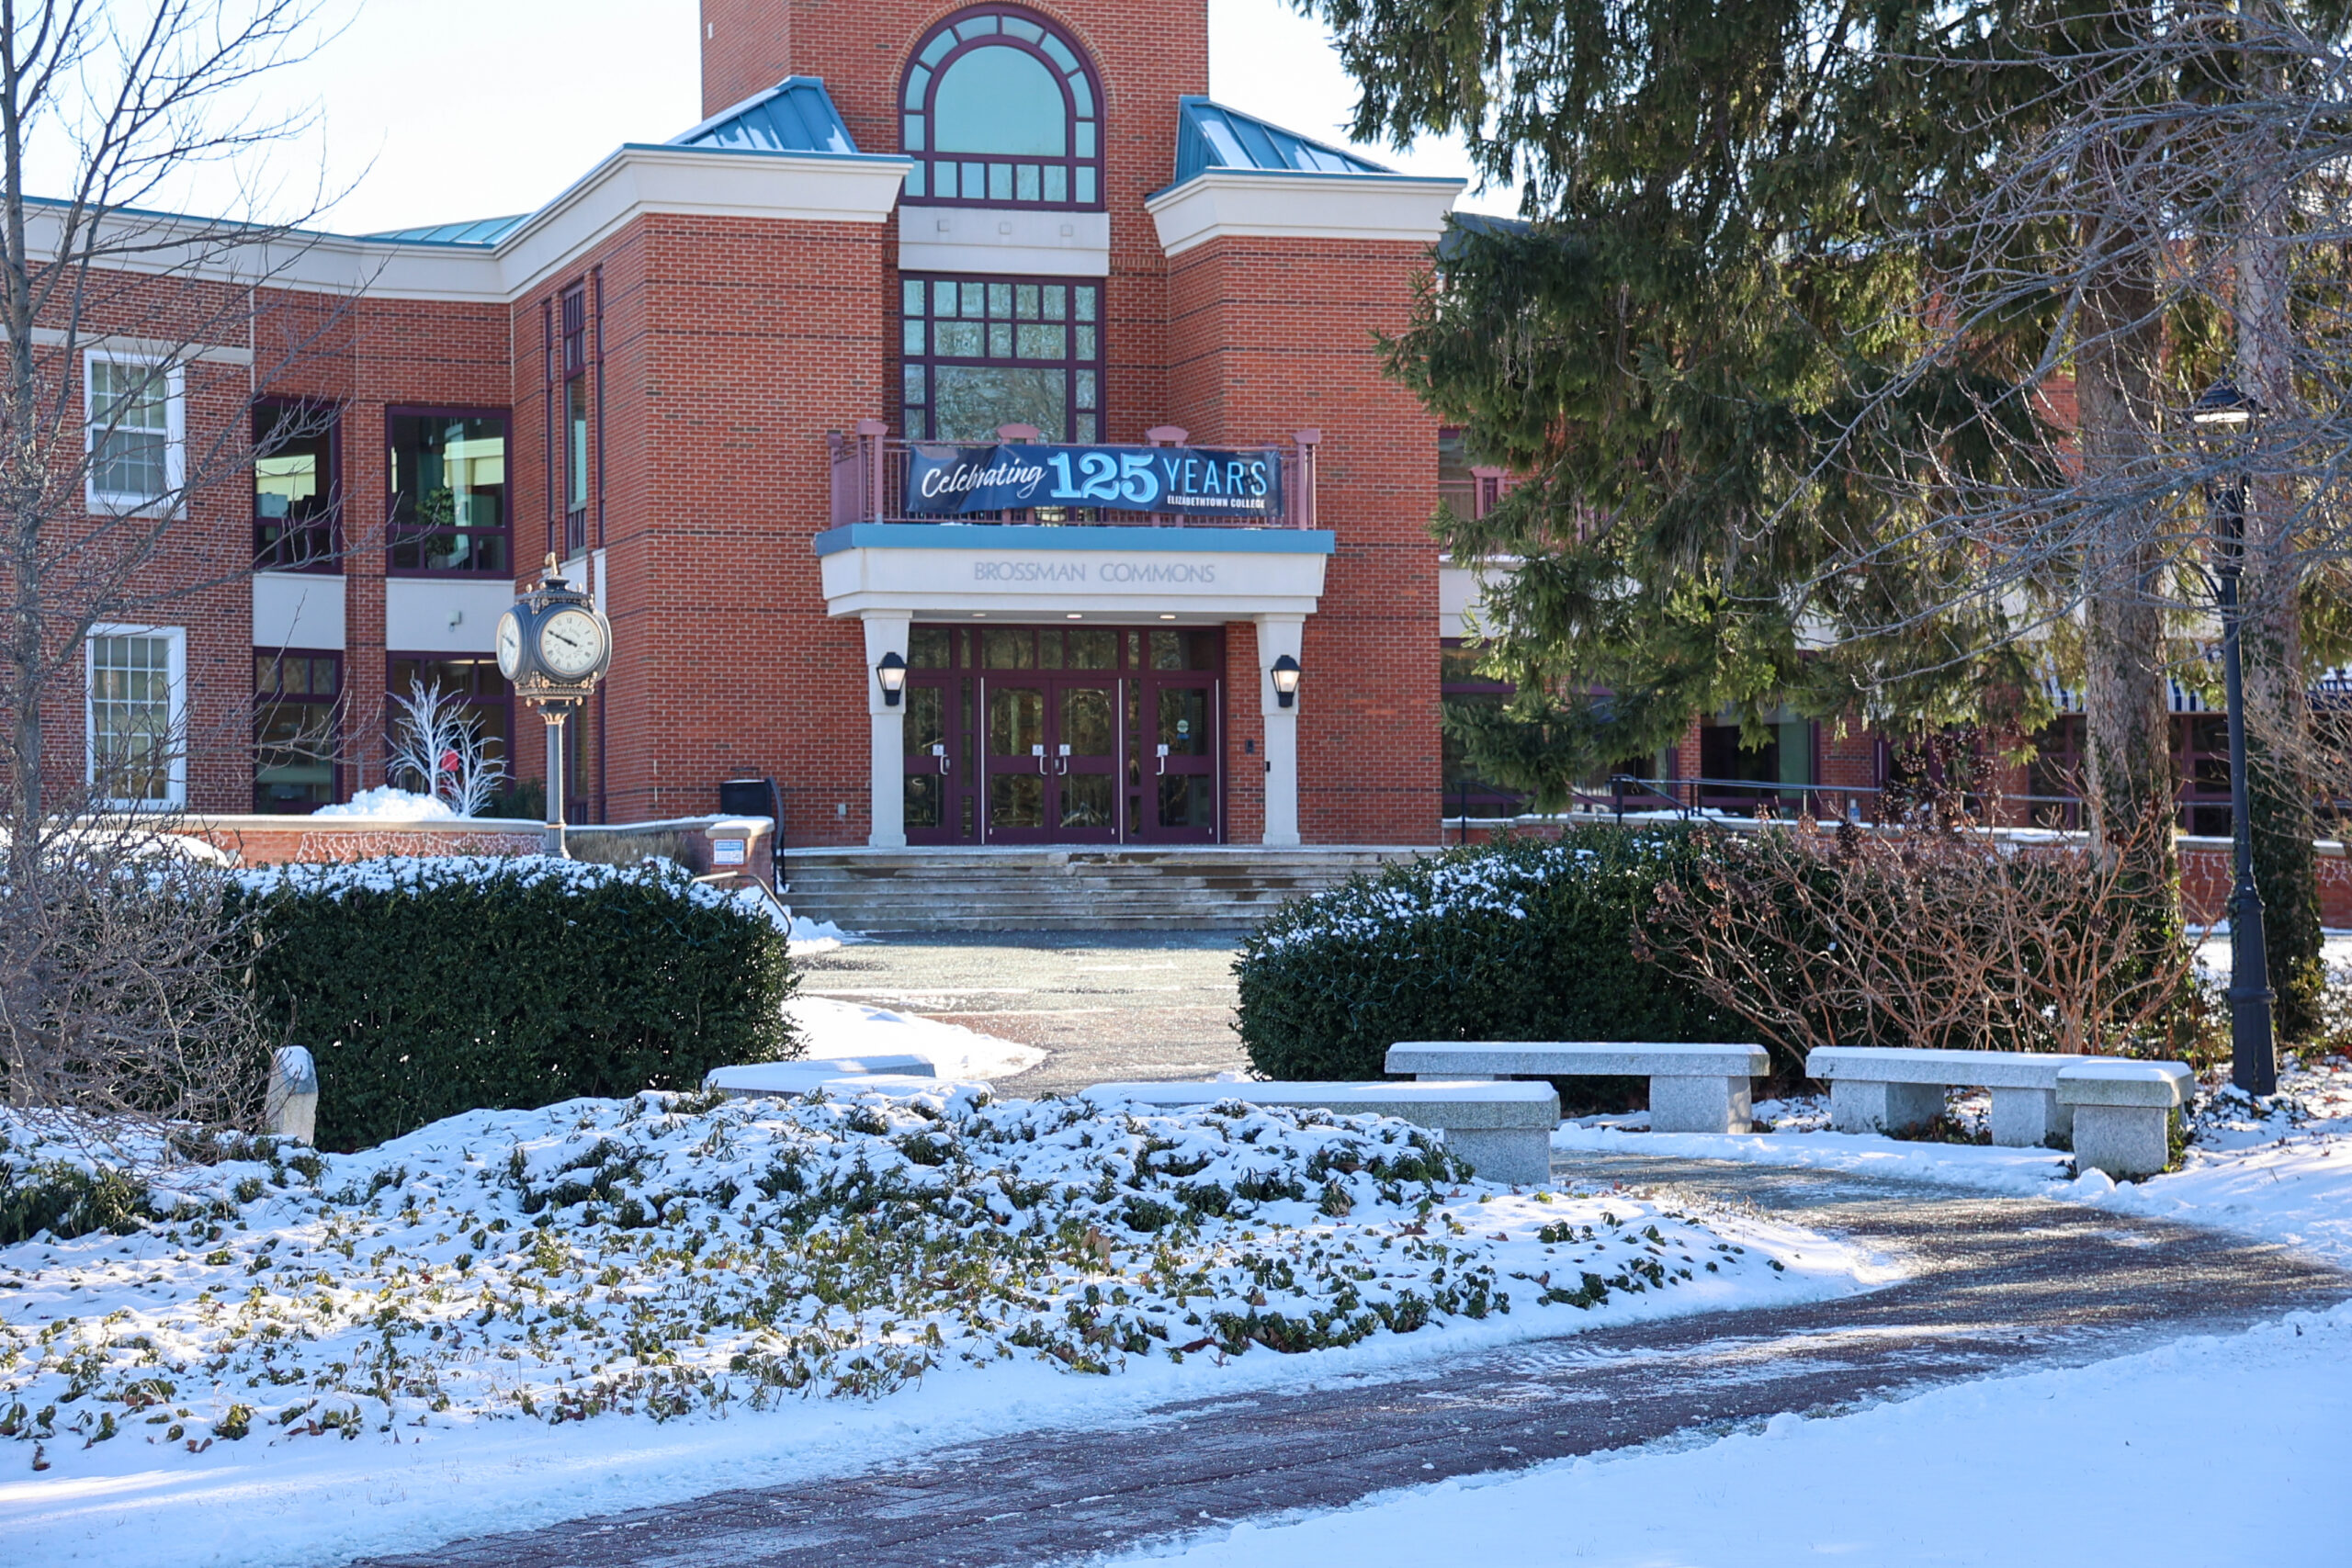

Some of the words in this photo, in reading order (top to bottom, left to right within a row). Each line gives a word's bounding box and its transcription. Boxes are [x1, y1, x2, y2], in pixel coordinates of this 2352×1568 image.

[922, 457, 1046, 499] Celebrating
[1046, 451, 1159, 503] 125
[1162, 457, 1267, 496] YEARS
[1167, 495, 1228, 507] ELIZABETHTOWN
[1230, 498, 1265, 509] COLLEGE
[974, 561, 1086, 582] BROSSMAN
[1099, 563, 1216, 583] COMMONS
